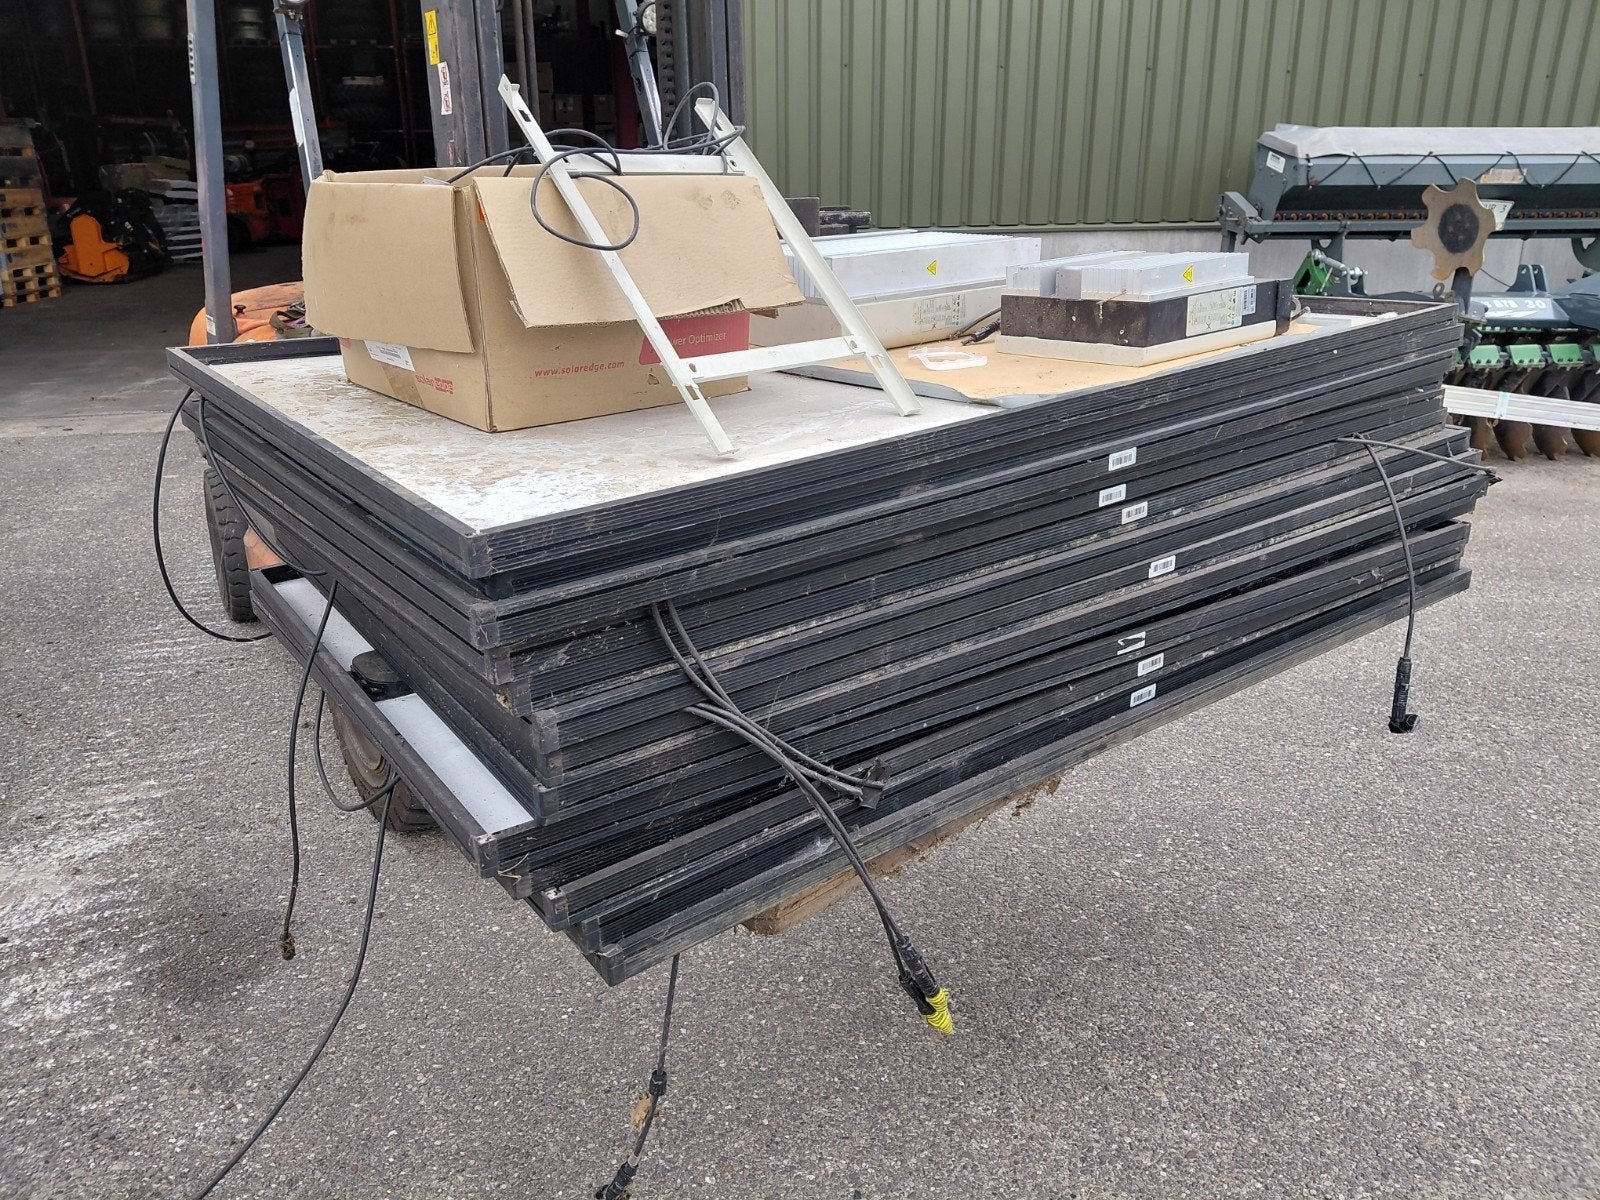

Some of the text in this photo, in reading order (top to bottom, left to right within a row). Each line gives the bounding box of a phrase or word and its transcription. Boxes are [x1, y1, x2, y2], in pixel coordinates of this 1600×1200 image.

[1525, 299, 1546, 309] 30
[688, 332, 727, 346] Optimizer
[534, 361, 625, 377] www.solaredge.com
